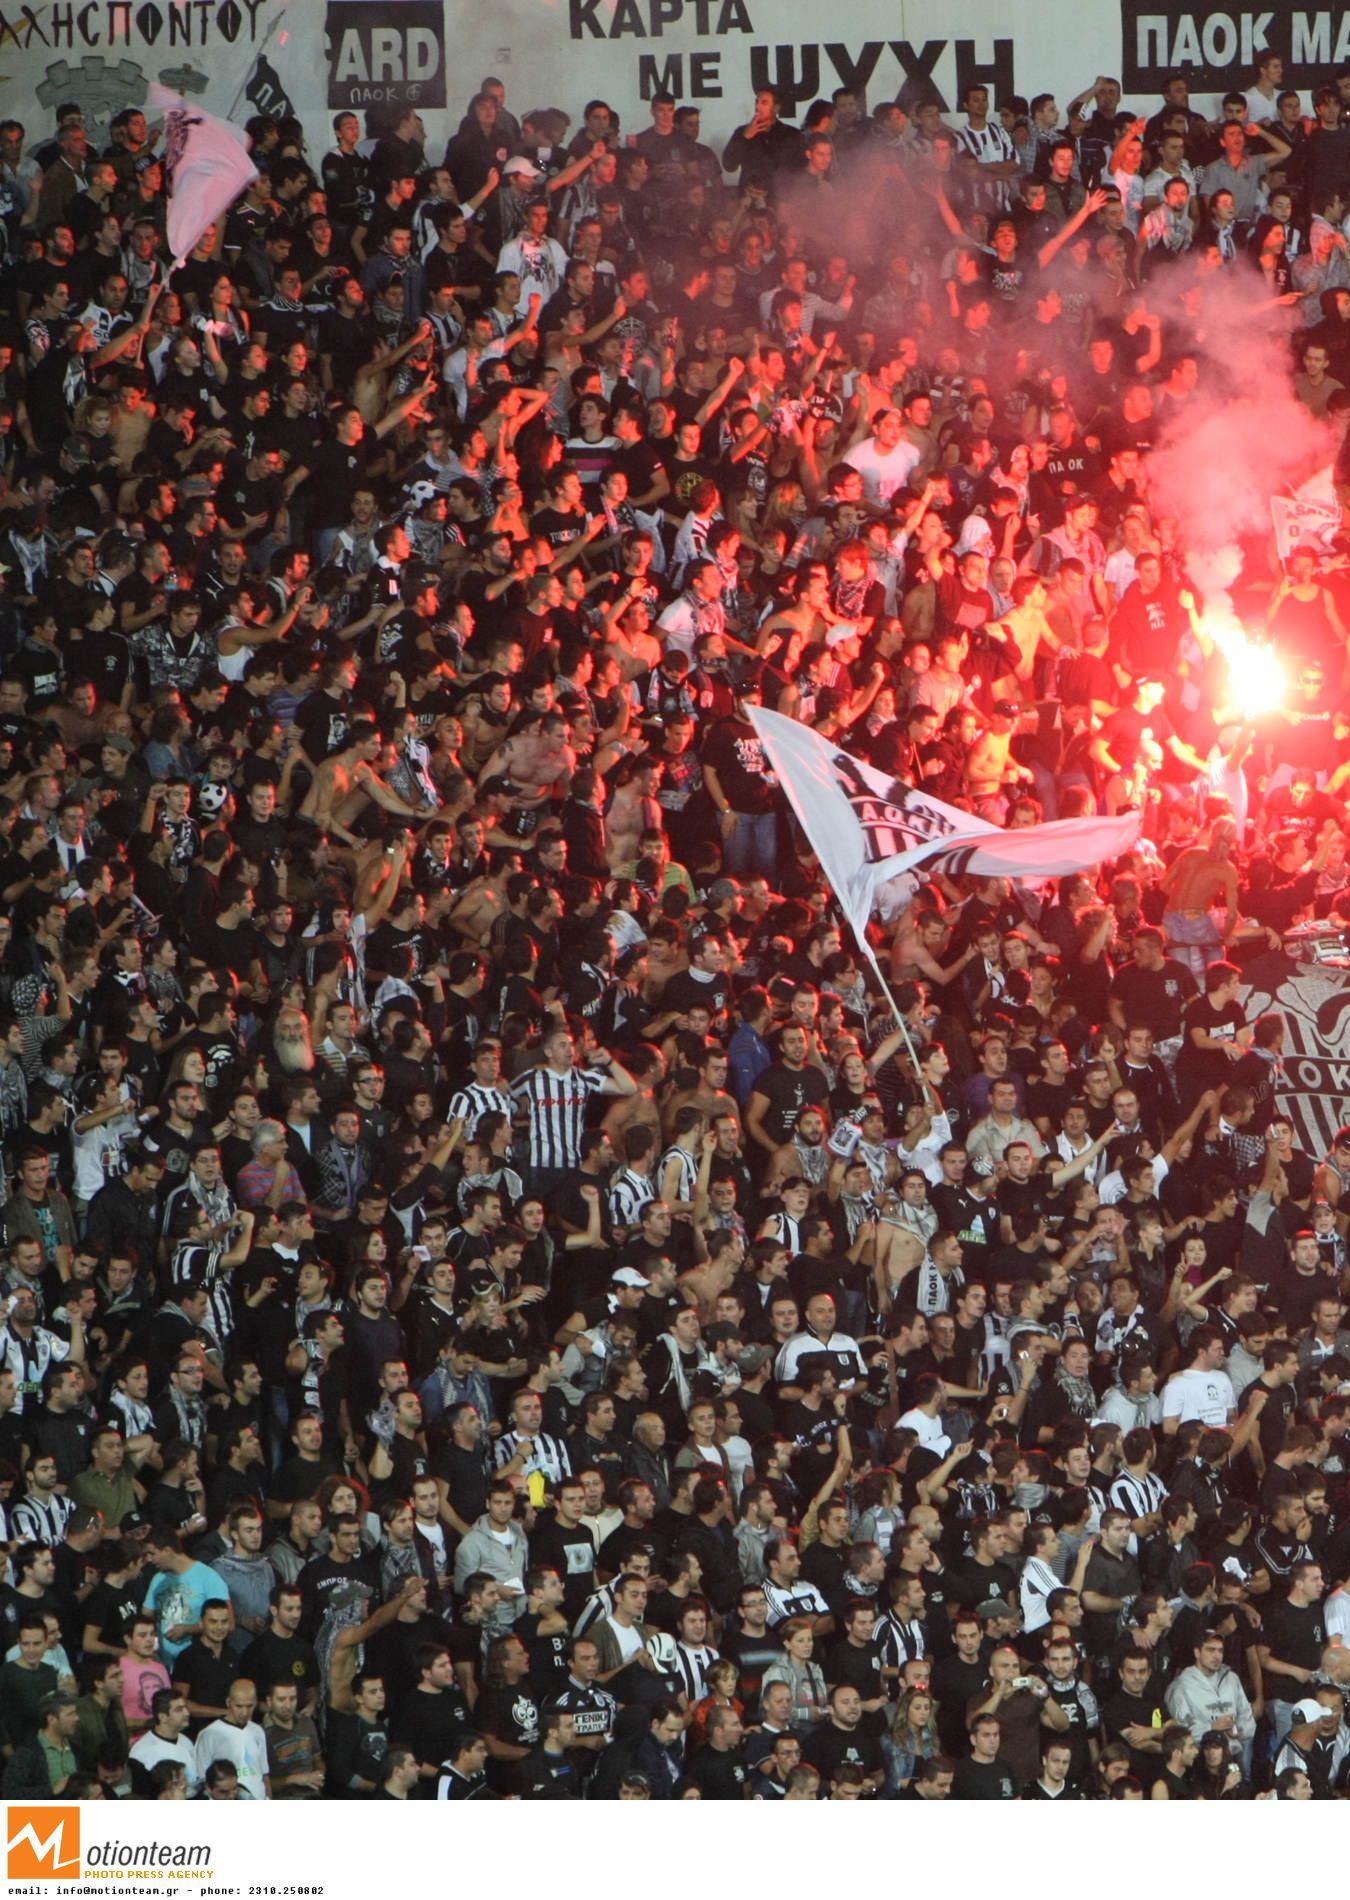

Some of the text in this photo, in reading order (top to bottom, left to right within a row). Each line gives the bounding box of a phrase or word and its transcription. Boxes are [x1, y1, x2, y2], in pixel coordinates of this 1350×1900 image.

[569, 0, 754, 40] ΚΑΡΤΑ
[1136, 11, 1274, 68] ΠΑΟΚ
[323, 26, 440, 82] ARD
[638, 39, 1015, 119] ΜΕ ΨΥΧΗ
